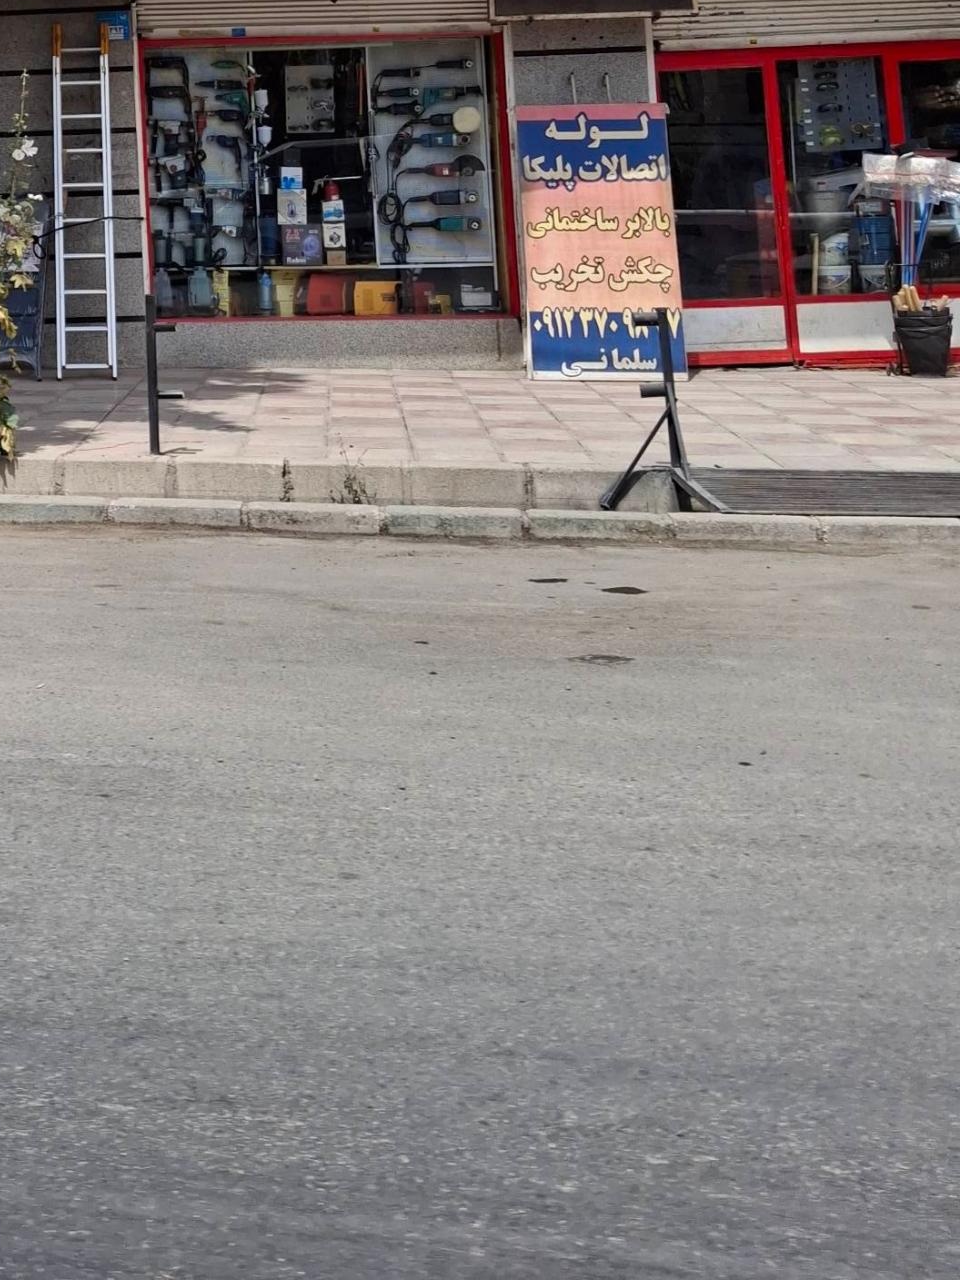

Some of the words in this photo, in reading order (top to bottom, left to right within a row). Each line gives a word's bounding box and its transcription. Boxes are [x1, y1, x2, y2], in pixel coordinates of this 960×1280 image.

[544, 112, 649, 149] لوله
[522, 154, 574, 191] پلیکا
[578, 153, 668, 182] اتصالات
[527, 206, 619, 238] ساختمانی
[622, 206, 671, 239] بالابر
[531, 256, 605, 292] تخریب
[608, 256, 674, 293] چکش
